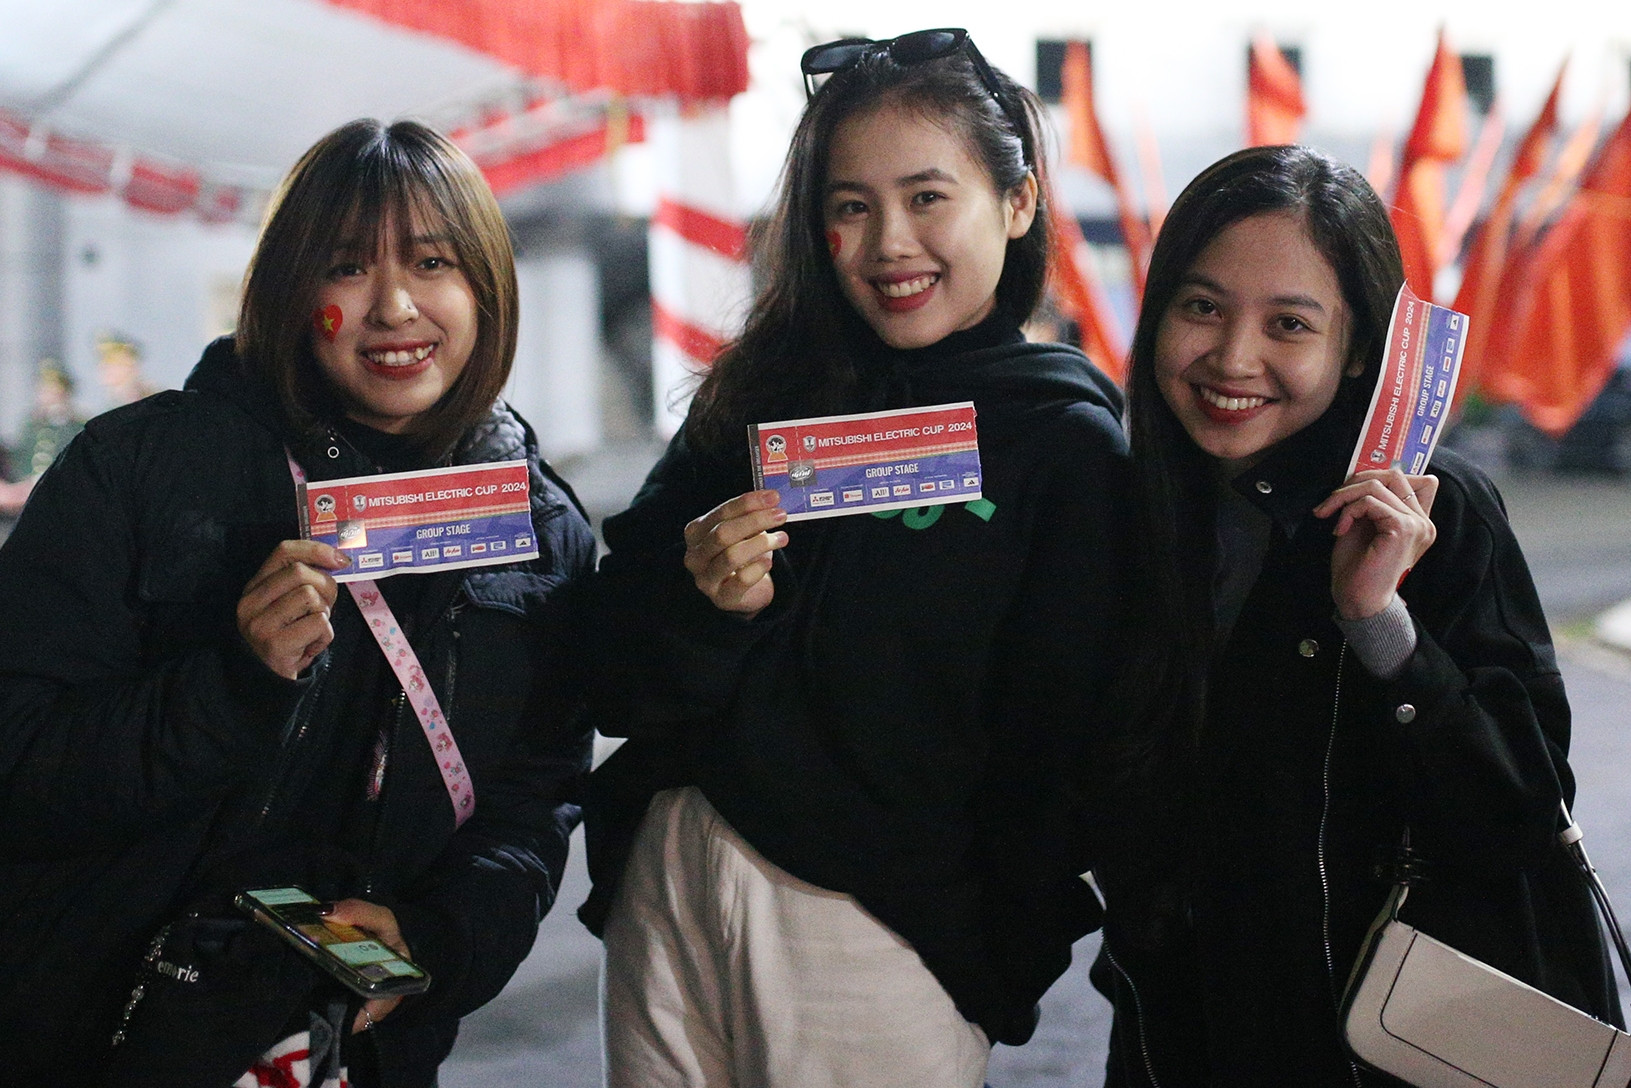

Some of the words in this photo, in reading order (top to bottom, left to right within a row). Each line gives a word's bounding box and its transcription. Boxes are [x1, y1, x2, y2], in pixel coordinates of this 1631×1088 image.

[1405, 301, 1415, 325] 2024
[1401, 327, 1411, 349] CUP
[1393, 350, 1408, 397] ELECTRIC
[1423, 365, 1435, 389] STAGE
[1417, 389, 1430, 417] GROUP
[818, 435, 872, 448] MITSUBISHI
[873, 427, 920, 442] ELECTRIC
[922, 425, 944, 435] CUP
[948, 421, 973, 433] 2024
[1378, 397, 1400, 451] MITSUBISHI
[865, 466, 893, 478] GROUP
[894, 463, 919, 474] STAGE
[368, 493, 424, 508] MITSUBISHI
[425, 487, 473, 502] ELECTRIC
[475, 485, 498, 496] CUP
[501, 482, 527, 493] 2024
[416, 527, 444, 539] GROUP
[446, 523, 471, 535] STAGE
